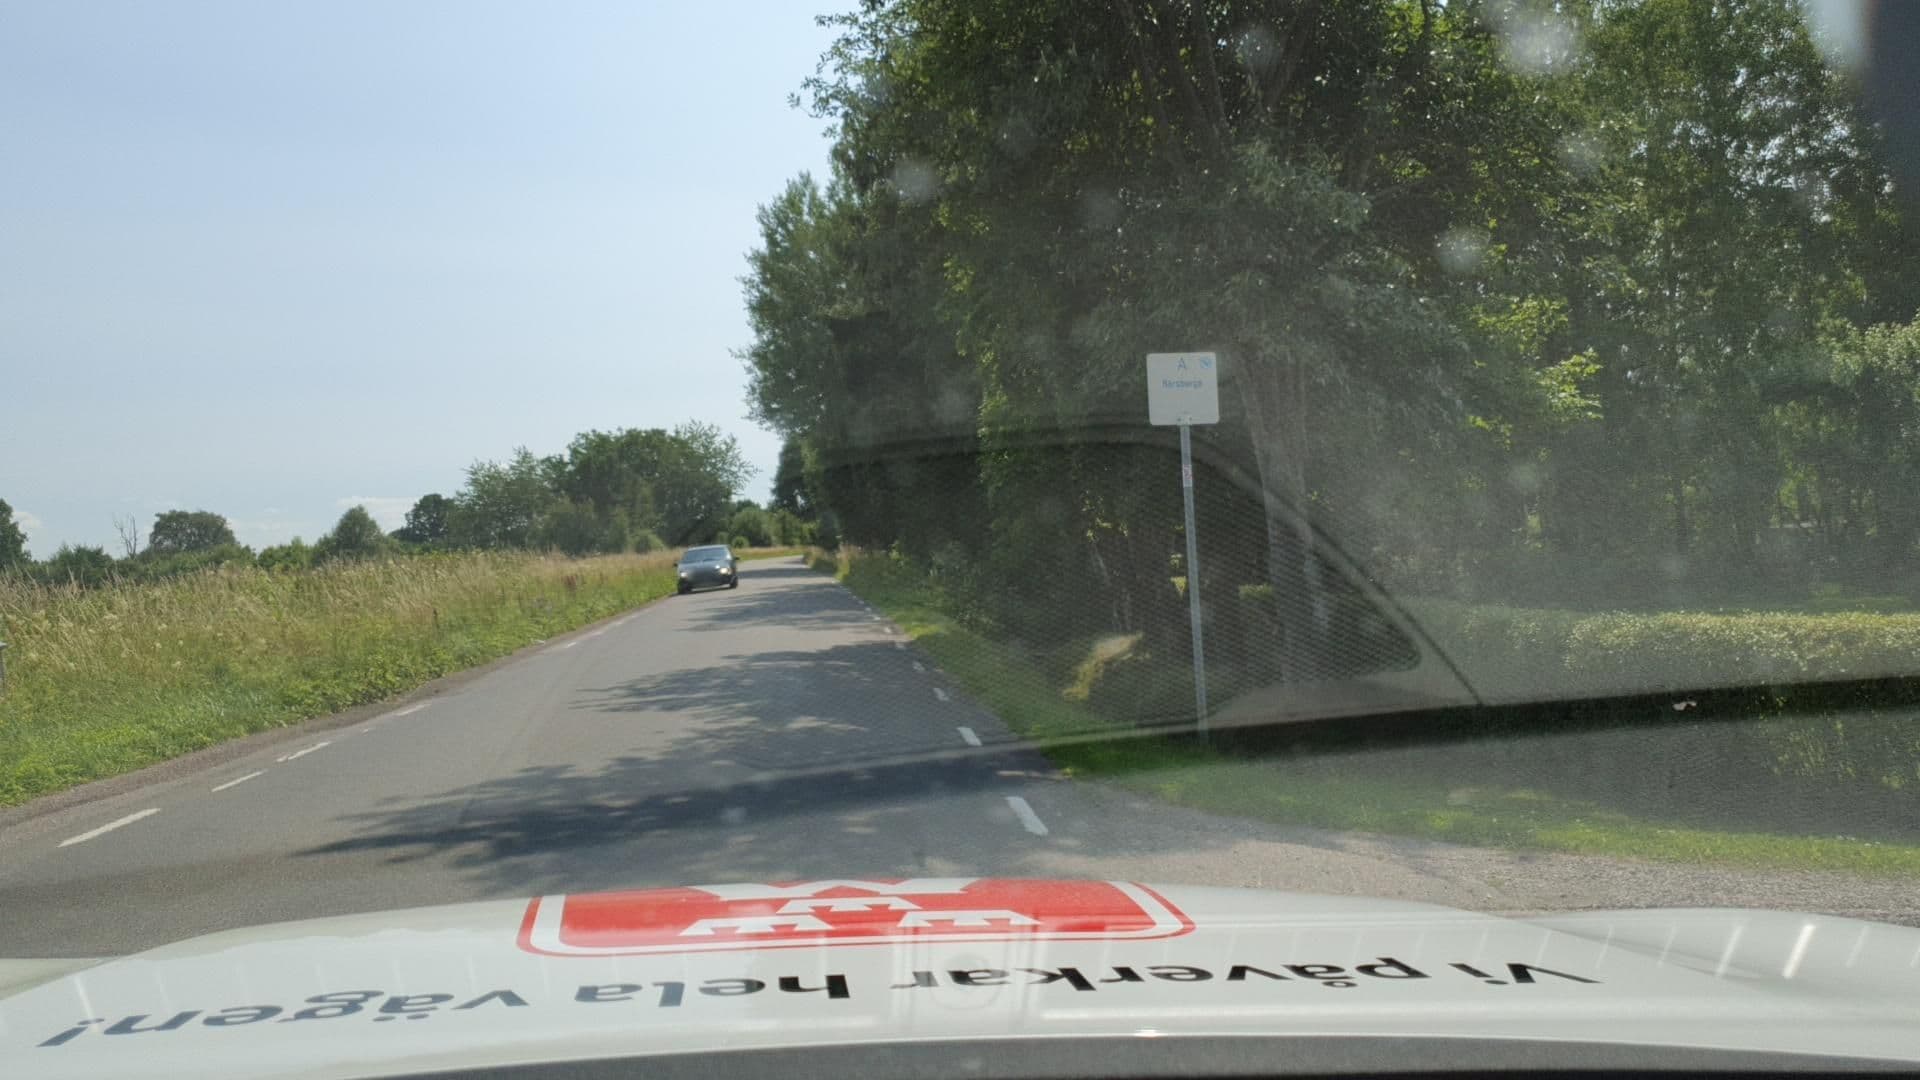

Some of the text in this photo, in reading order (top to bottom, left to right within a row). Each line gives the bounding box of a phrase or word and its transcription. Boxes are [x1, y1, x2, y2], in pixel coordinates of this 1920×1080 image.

[36, 956, 1603, 1048] Vi påverkar hela vägen!
